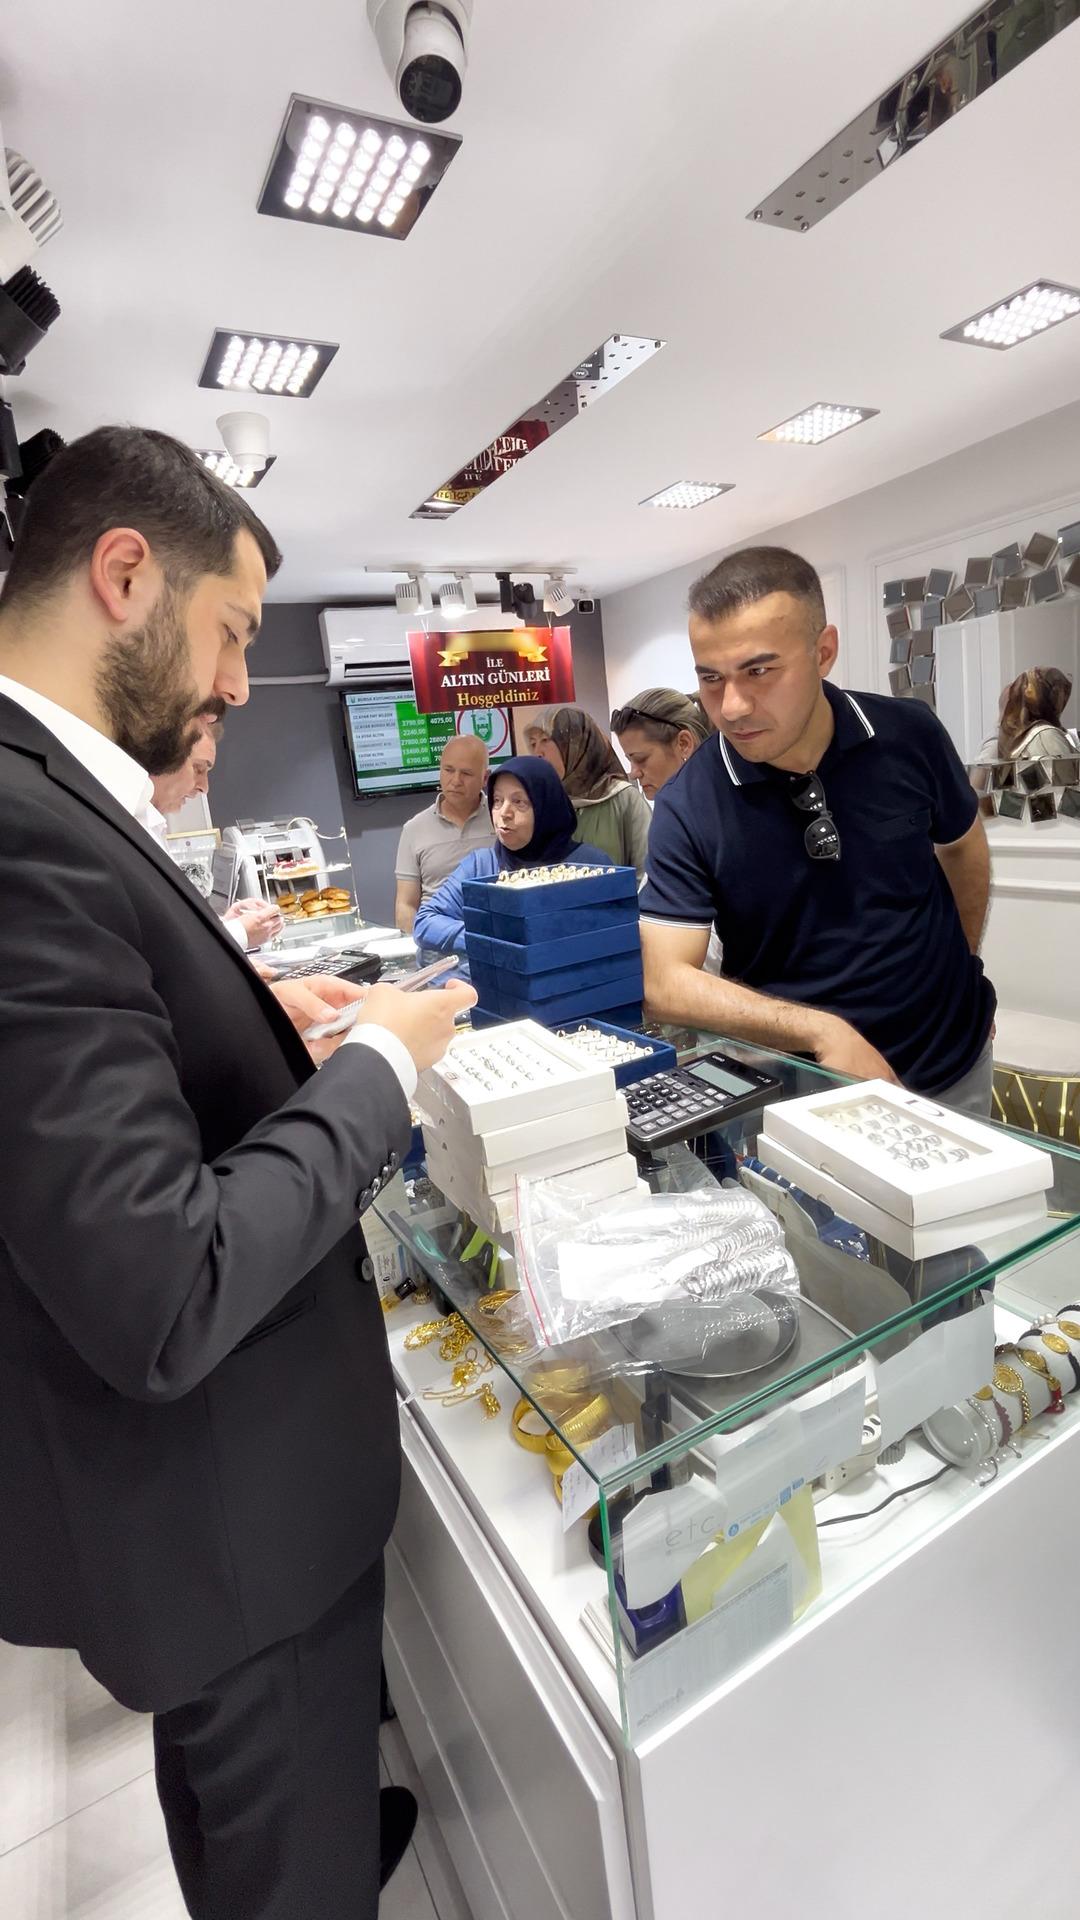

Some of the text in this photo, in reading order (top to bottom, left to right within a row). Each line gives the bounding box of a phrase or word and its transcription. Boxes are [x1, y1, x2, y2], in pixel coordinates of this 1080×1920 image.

[486, 657, 504, 668] İLE
[441, 666, 551, 688] ALTIN GÜNLERİ
[457, 689, 540, 708] Hoşgeldiniz
